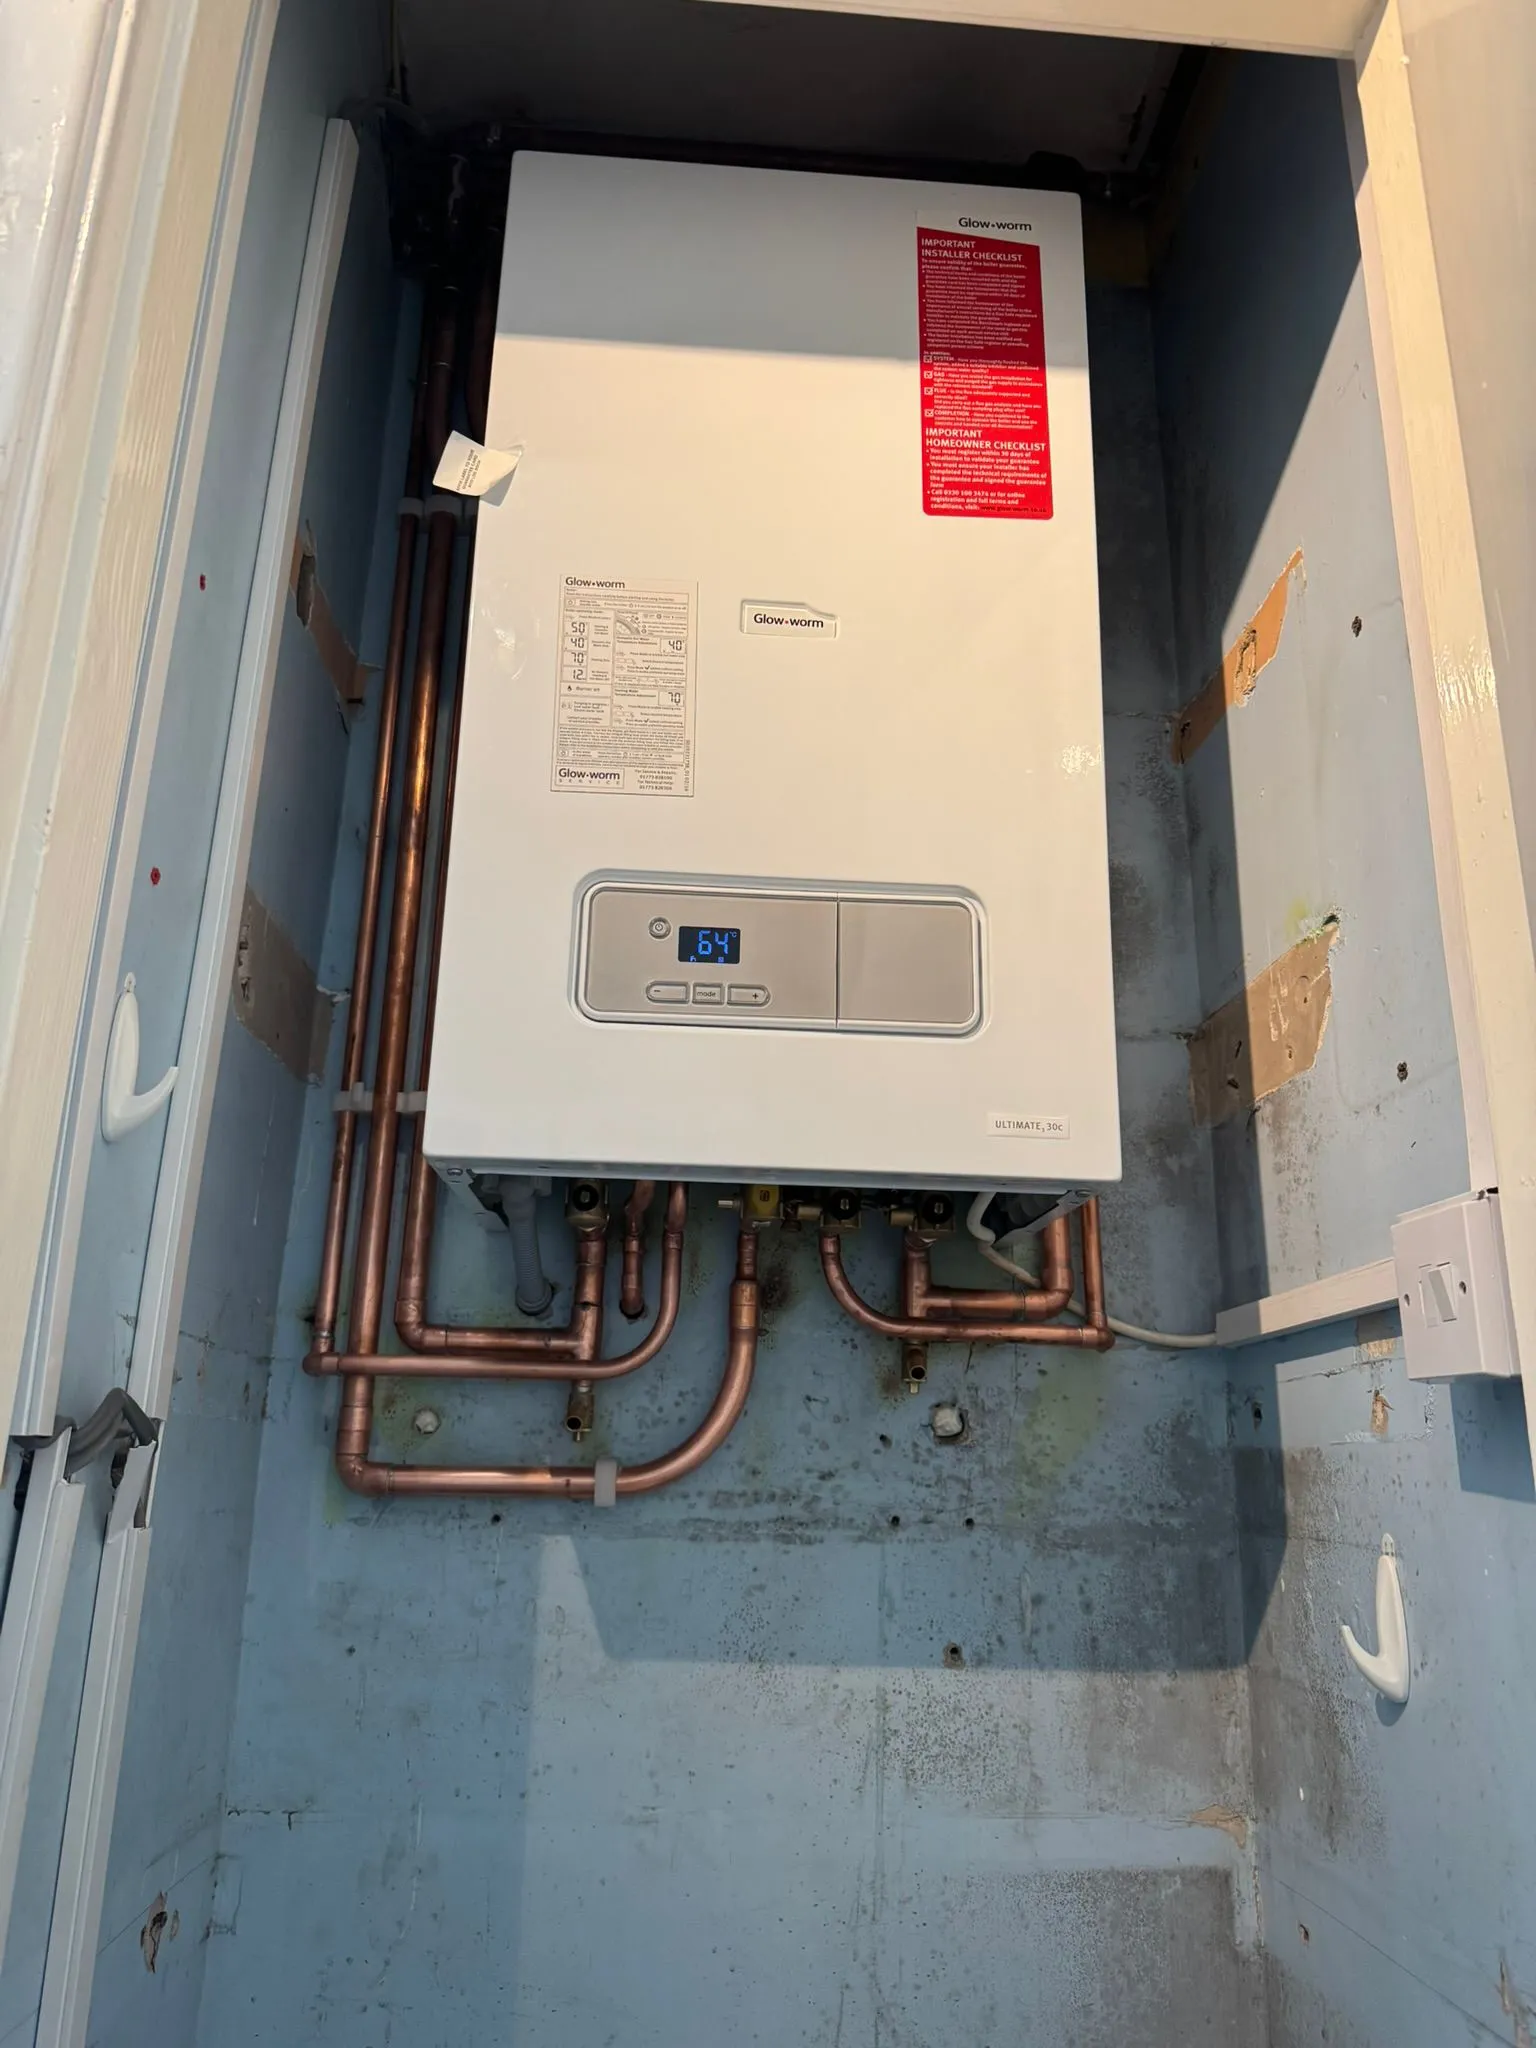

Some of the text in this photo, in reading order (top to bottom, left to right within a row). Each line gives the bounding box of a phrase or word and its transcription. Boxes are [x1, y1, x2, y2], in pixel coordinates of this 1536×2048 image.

[921, 238, 976, 248] IMPORTANT
[922, 249, 1023, 262] INSTALLER CHECKLIST
[925, 427, 982, 437] IMPORTANT
[925, 438, 1045, 451] HOMEOWNER CHECKLIST
[571, 622, 586, 633] 50
[570, 637, 585, 648] 40
[668, 640, 682, 651] 40
[571, 652, 584, 664] 70
[573, 669, 584, 680] 12
[668, 691, 681, 703] 70
[697, 930, 729, 955] 64
